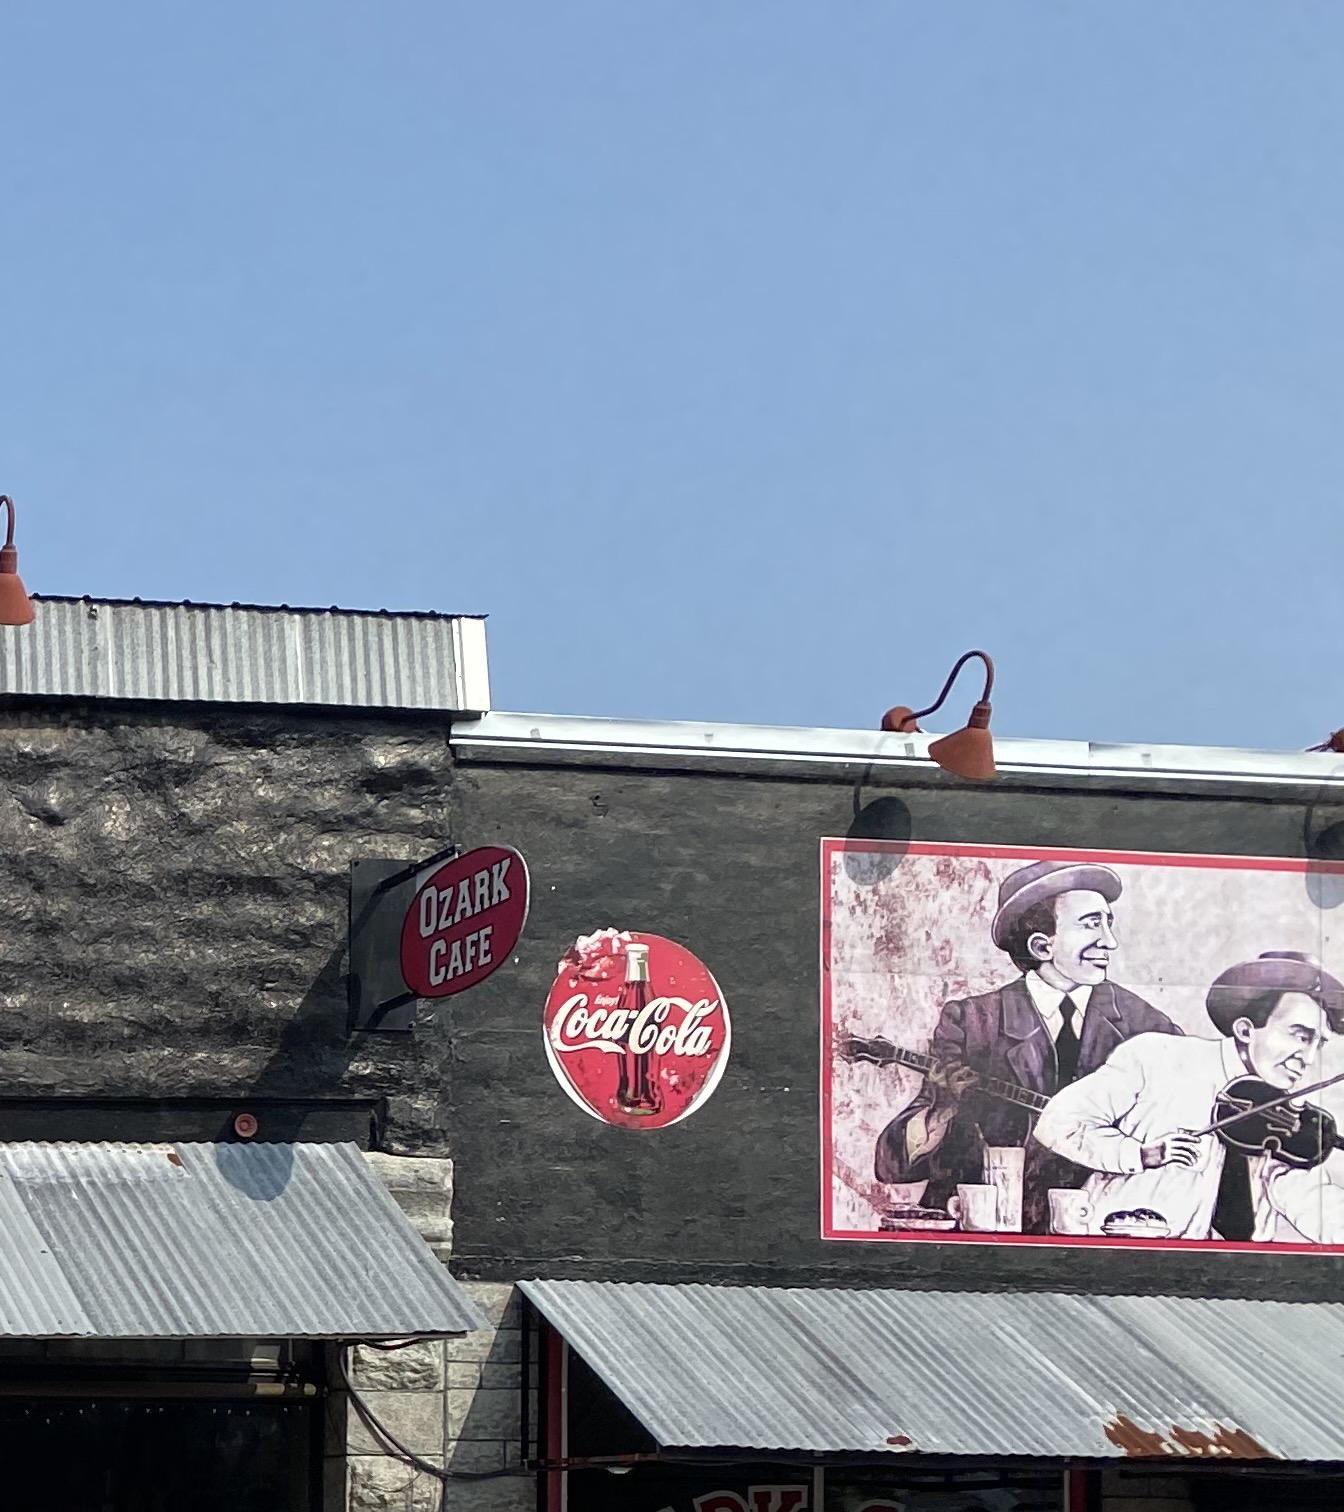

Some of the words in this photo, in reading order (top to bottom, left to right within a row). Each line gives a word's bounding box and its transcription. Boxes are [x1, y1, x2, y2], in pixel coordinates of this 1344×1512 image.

[419, 857, 511, 938] OZARK
[430, 925, 493, 986] CAFE
[551, 993, 719, 1057] Coca-Cola
